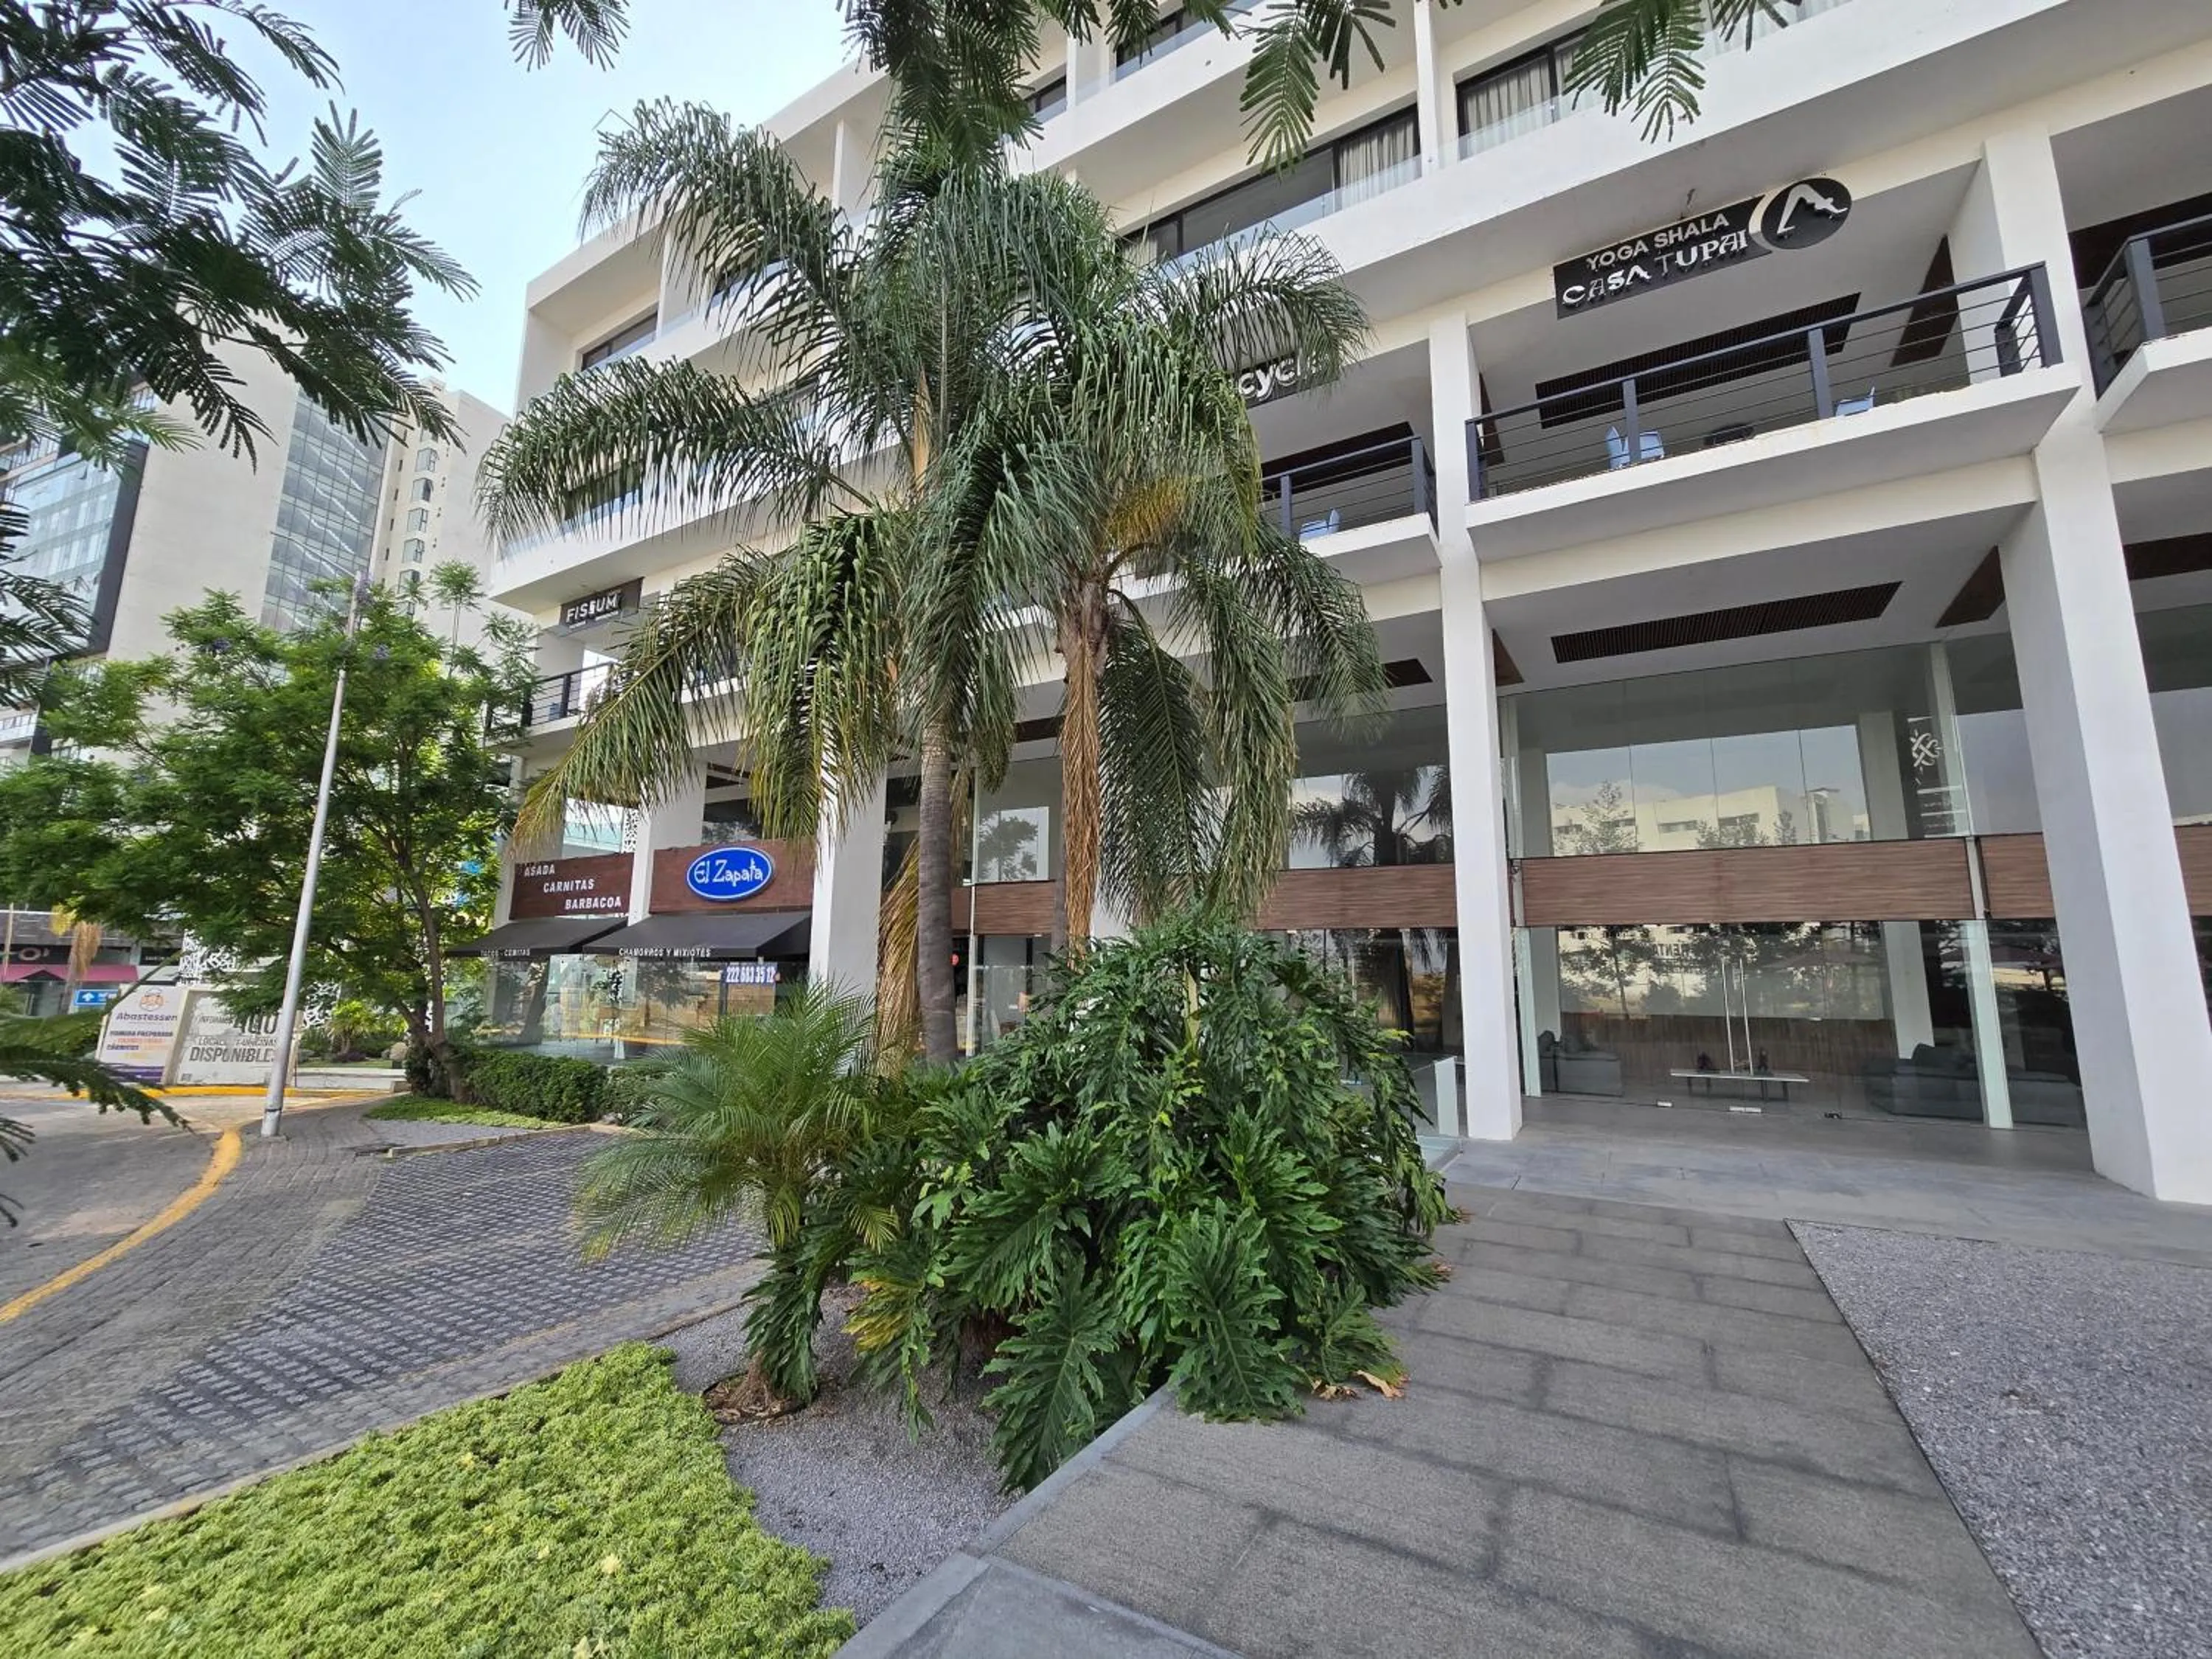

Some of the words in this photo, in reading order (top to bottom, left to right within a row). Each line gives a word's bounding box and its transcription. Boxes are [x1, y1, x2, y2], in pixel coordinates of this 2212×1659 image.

[1586, 240, 1649, 271] YOGA
[1654, 213, 1729, 248] SHALA
[1562, 265, 1652, 304] CASA
[1655, 229, 1748, 276] TUPAI
[524, 864, 555, 877] ASADA
[694, 860, 710, 884] El
[712, 856, 763, 887] Zapata
[543, 878, 596, 893] CARNITAS
[565, 896, 622, 910] BARBACOA
[666, 947, 672, 956] Y
[726, 967, 740, 983] 222
